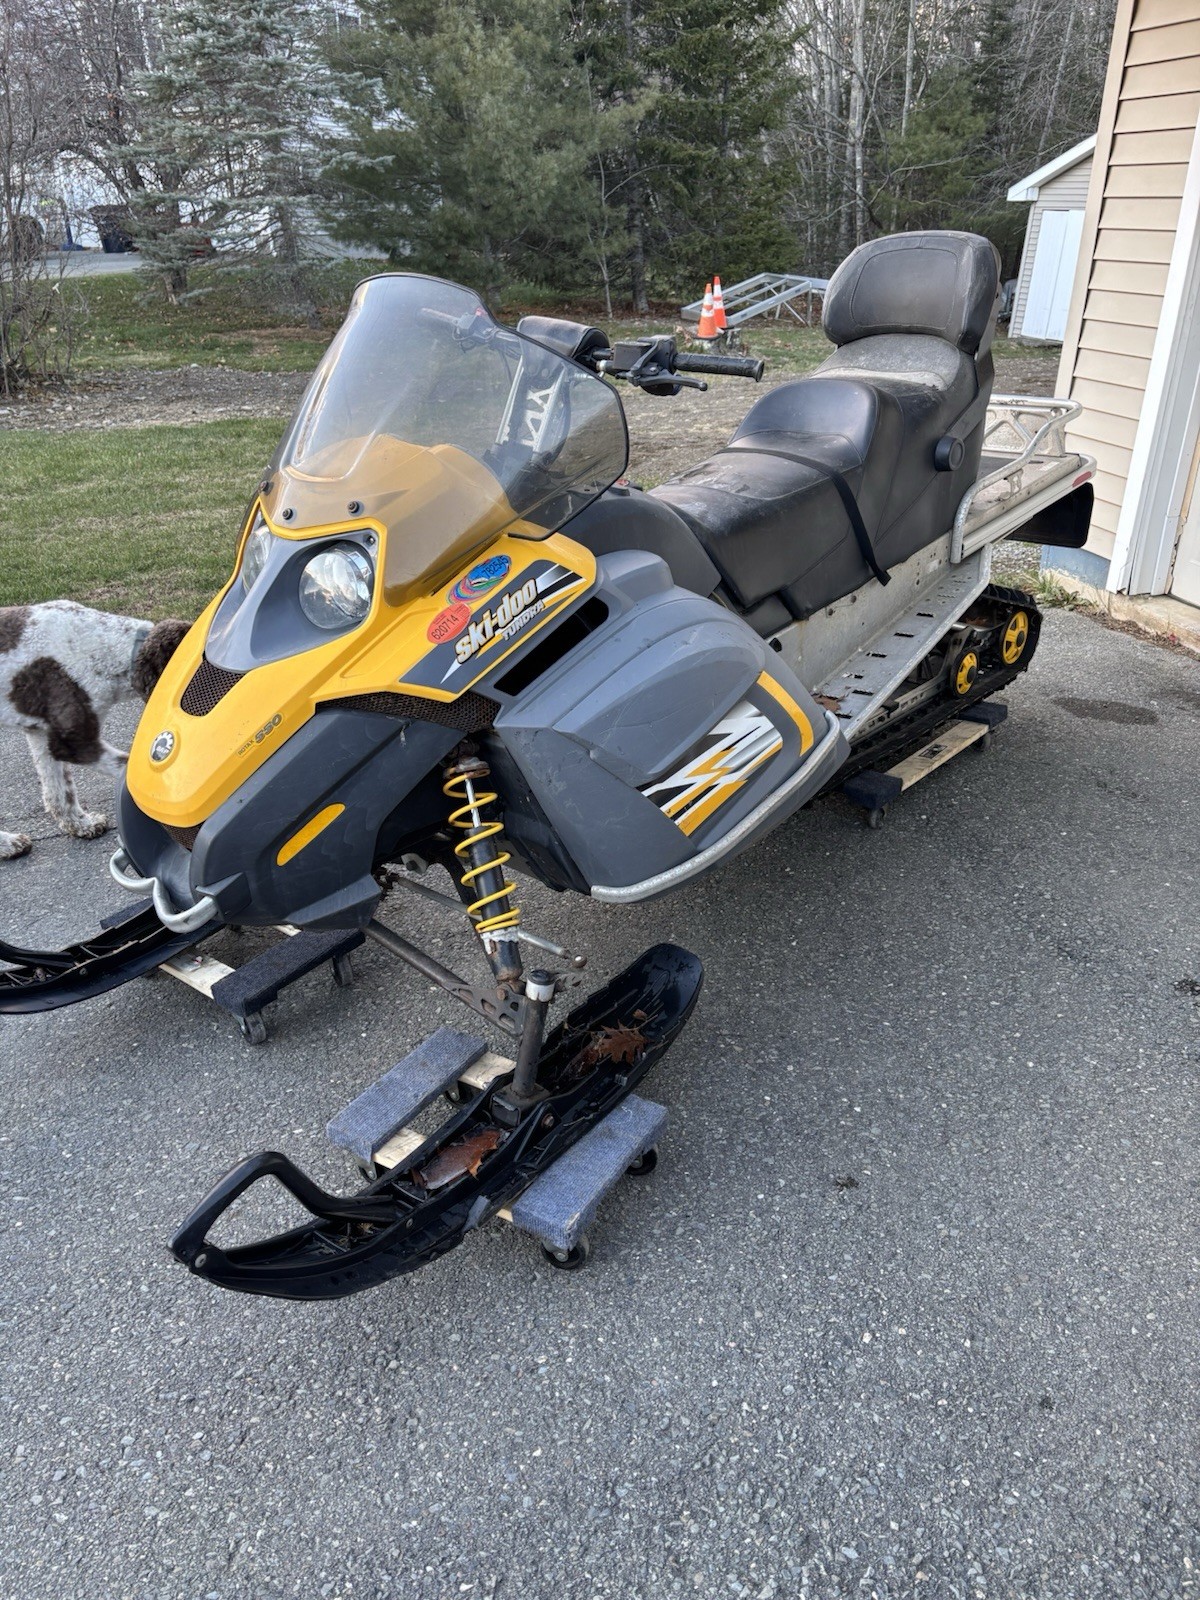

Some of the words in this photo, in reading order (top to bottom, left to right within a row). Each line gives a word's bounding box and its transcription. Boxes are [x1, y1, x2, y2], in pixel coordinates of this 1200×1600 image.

[431, 614, 459, 640] 620714
[501, 599, 546, 641] TUNDRA
[255, 713, 282, 744] 550
